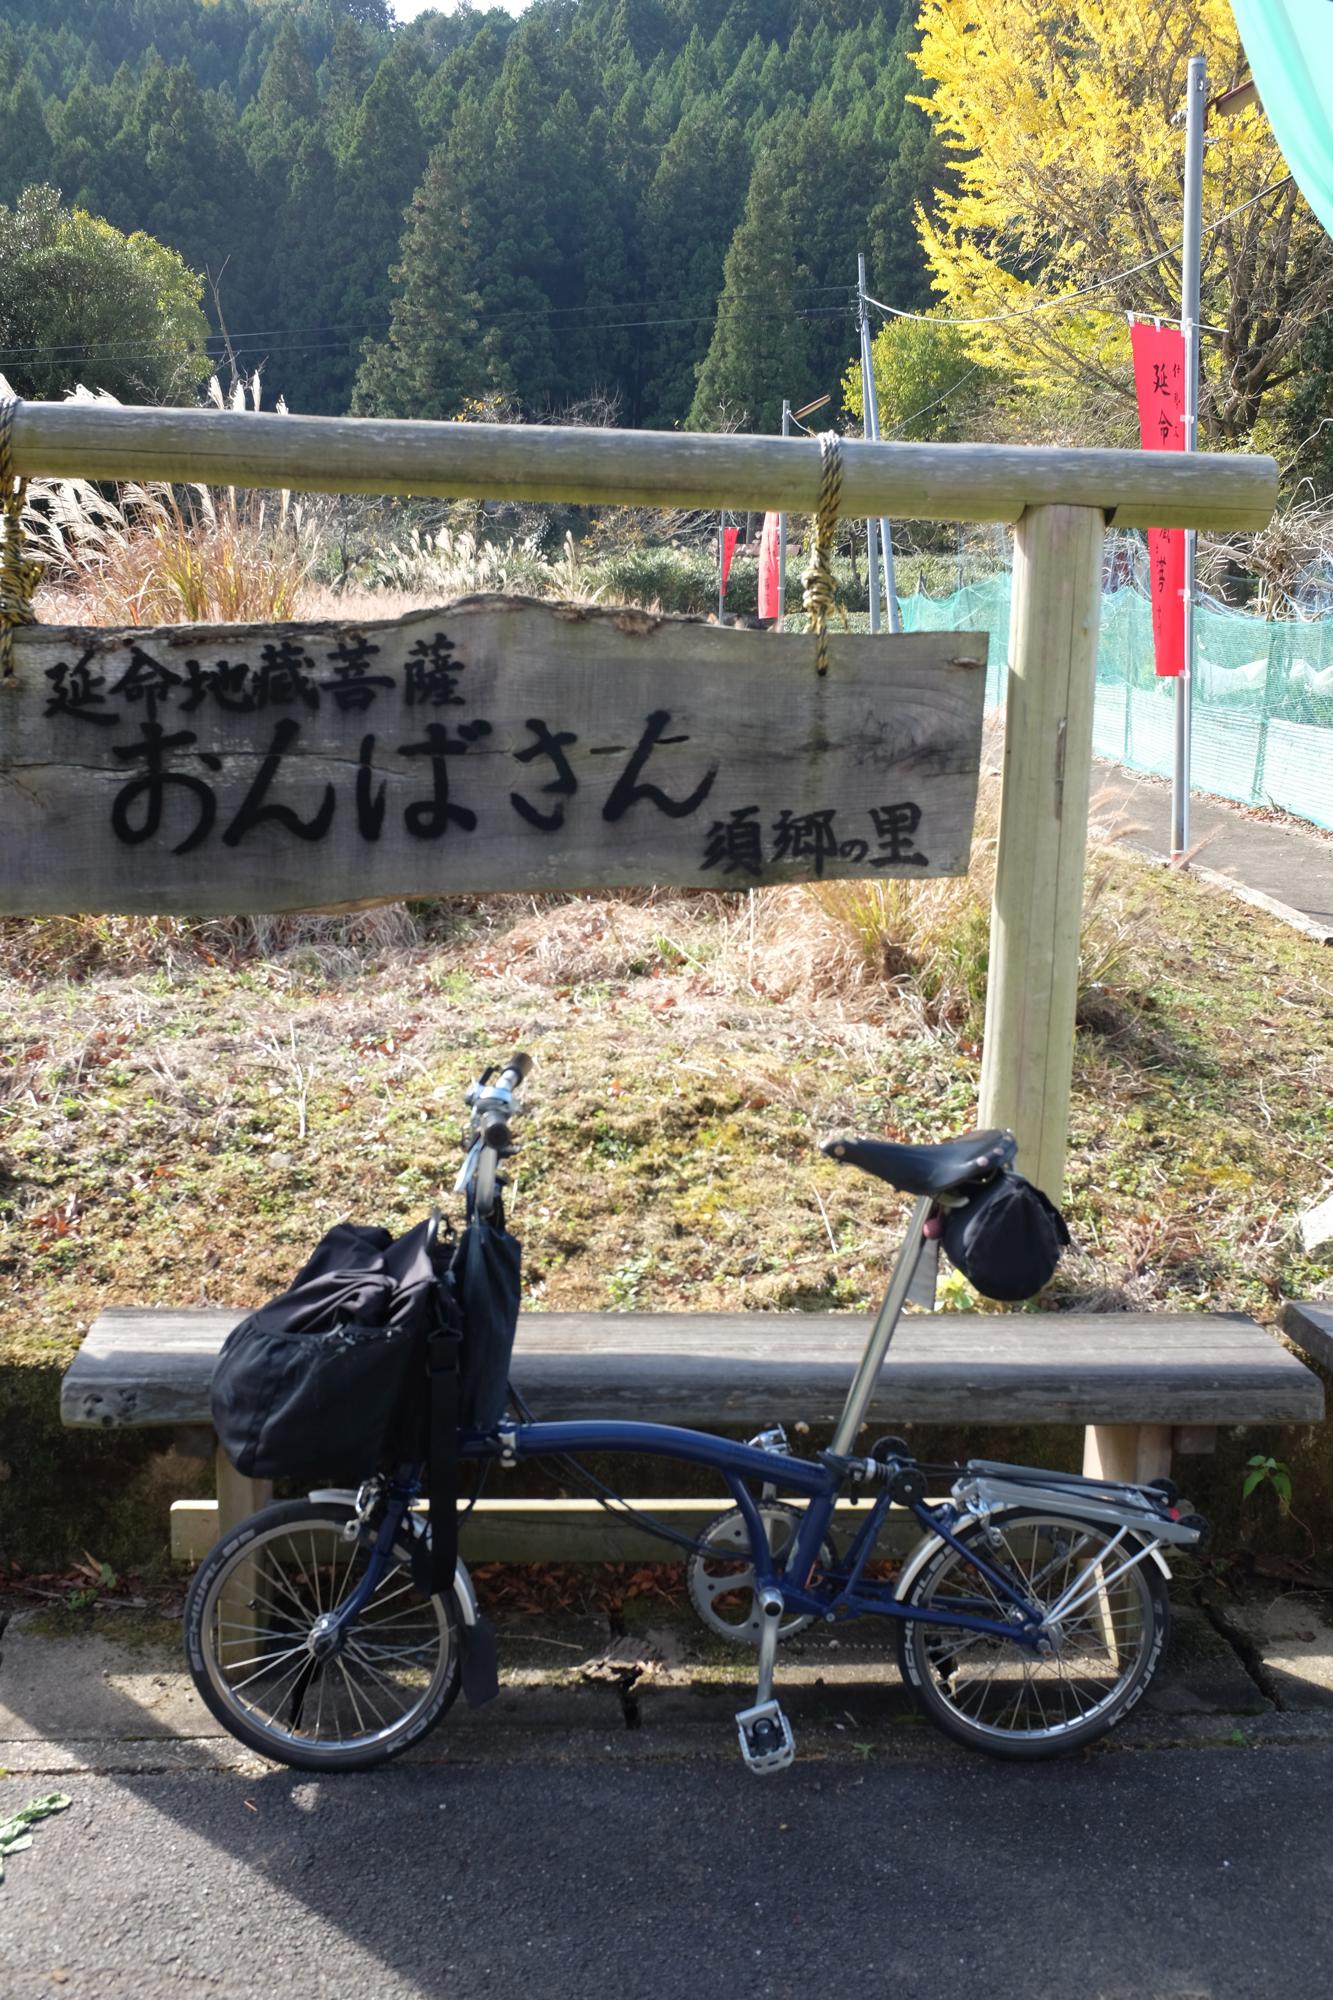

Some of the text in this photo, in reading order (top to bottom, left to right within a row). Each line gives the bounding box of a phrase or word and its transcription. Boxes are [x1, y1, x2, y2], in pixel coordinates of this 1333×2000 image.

[43, 633, 467, 725] 延命地蔵菩薩
[111, 710, 719, 855] おんばさん
[700, 802, 929, 878] 須郷の里
[386, 1657, 457, 1752] KOJAK
[1108, 1623, 1164, 1727] KOJAK
